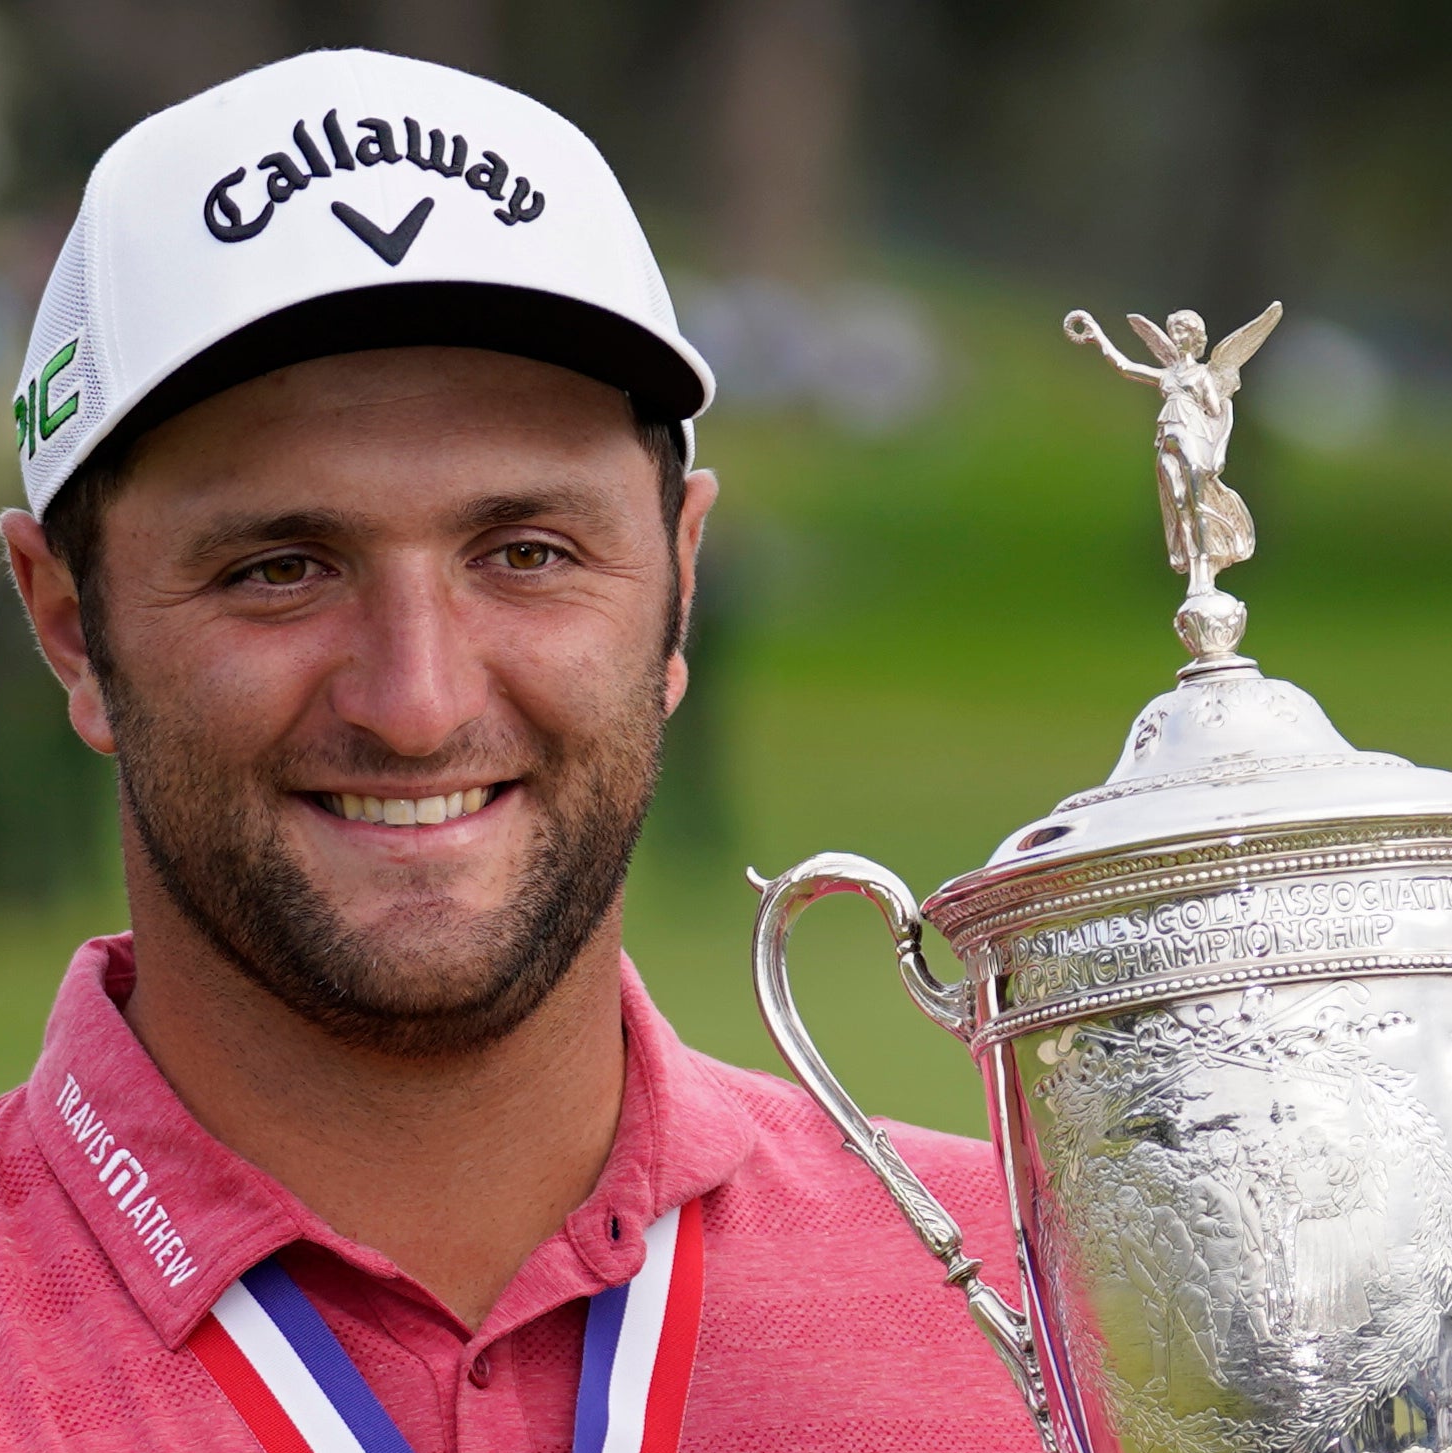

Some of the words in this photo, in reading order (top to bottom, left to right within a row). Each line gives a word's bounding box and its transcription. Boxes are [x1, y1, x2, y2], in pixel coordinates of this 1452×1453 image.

[203, 108, 546, 243] Callaway
[1154, 886, 1260, 936] GOLF
[1014, 955, 1090, 1008] OPEN
[1092, 914, 1395, 987] CHAMPIONSHIP
